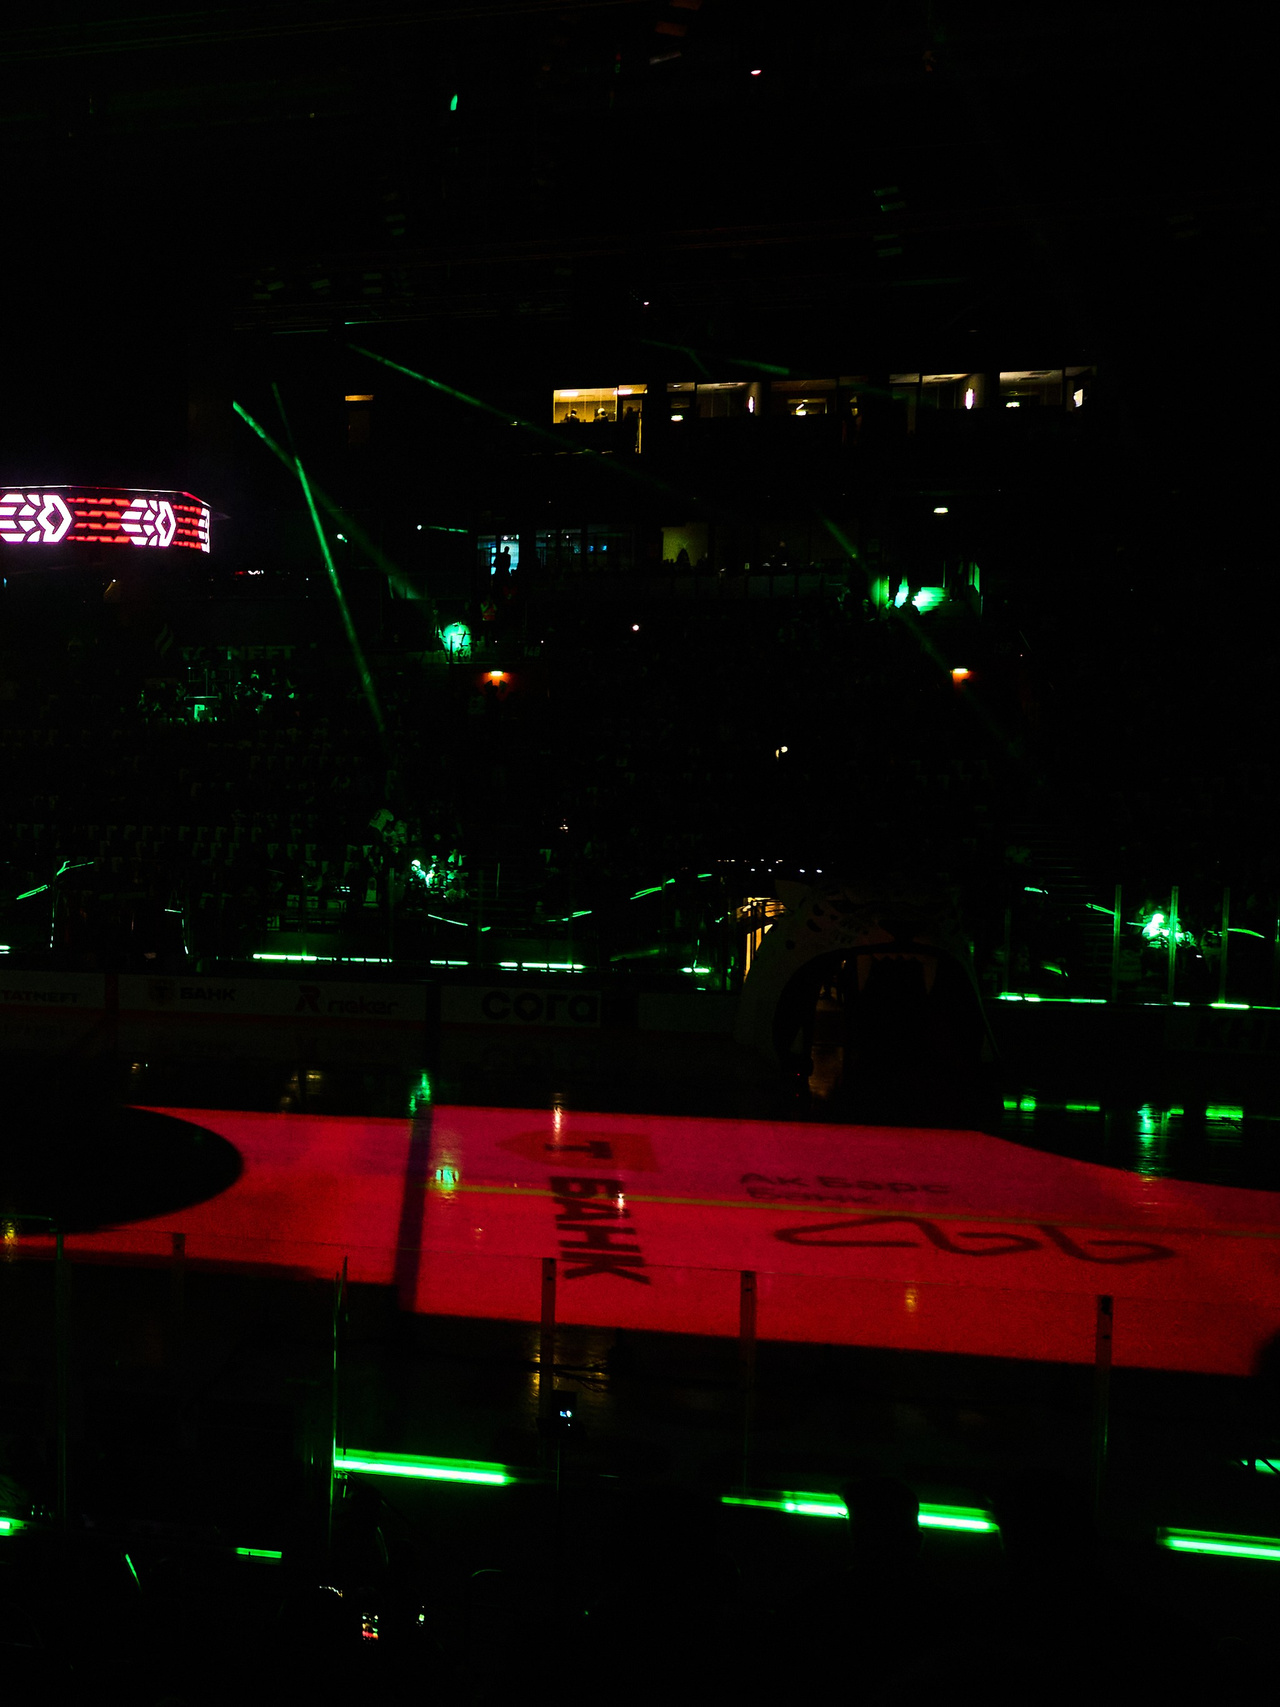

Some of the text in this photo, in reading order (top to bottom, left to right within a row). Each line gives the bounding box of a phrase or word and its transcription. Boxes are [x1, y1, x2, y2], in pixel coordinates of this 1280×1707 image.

[1, 990, 81, 1004] TATNEFT
[180, 987, 237, 1002] БАНК
[327, 996, 400, 1015] rieker
[549, 1176, 652, 1286] БАНК
